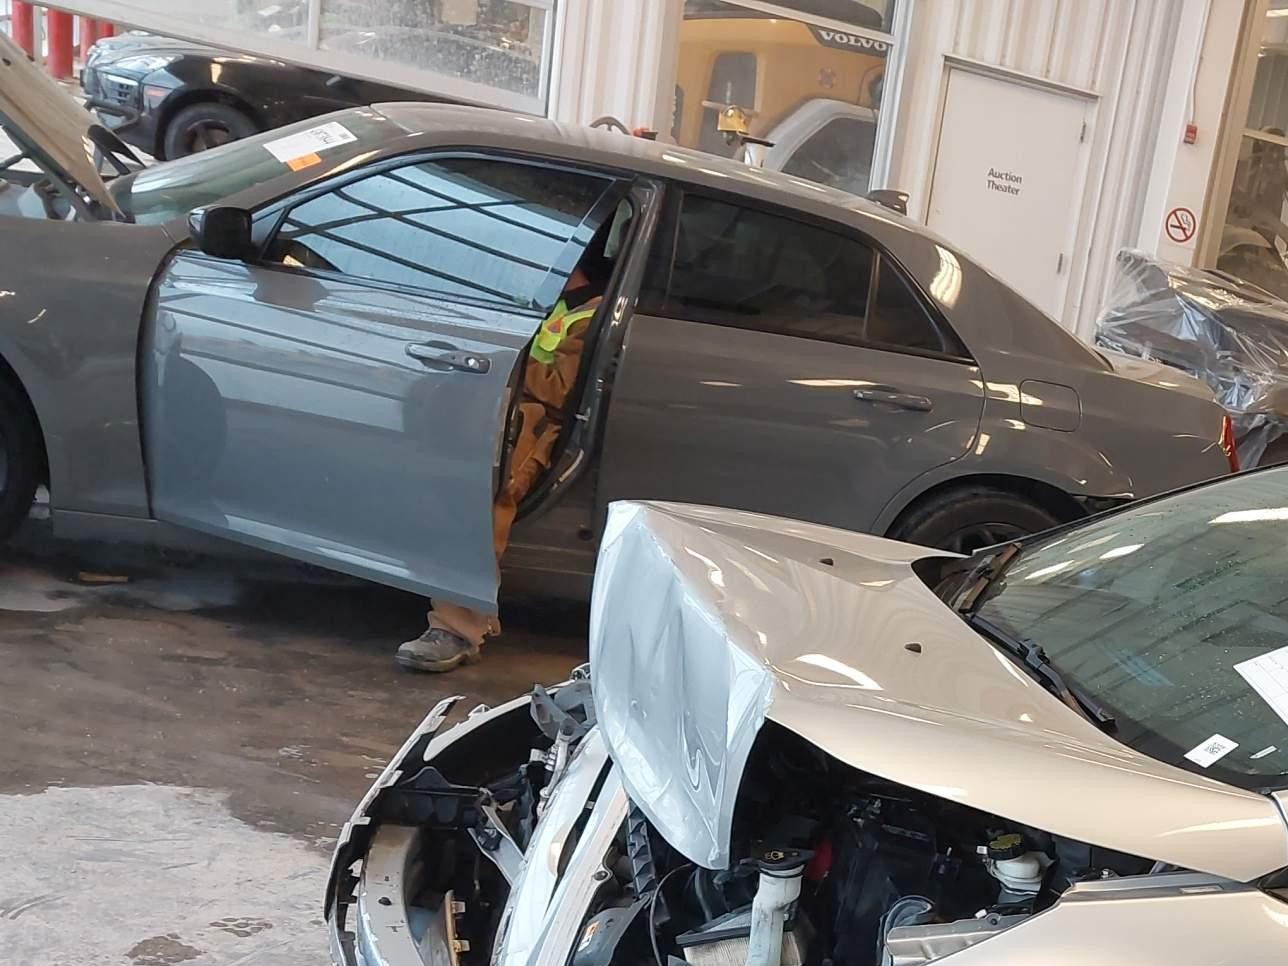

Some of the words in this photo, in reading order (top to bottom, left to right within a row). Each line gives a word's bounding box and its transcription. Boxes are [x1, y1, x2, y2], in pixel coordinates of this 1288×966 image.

[818, 29, 887, 51] VOLVO
[987, 167, 1022, 184] Auction
[987, 179, 1020, 195] Theater
